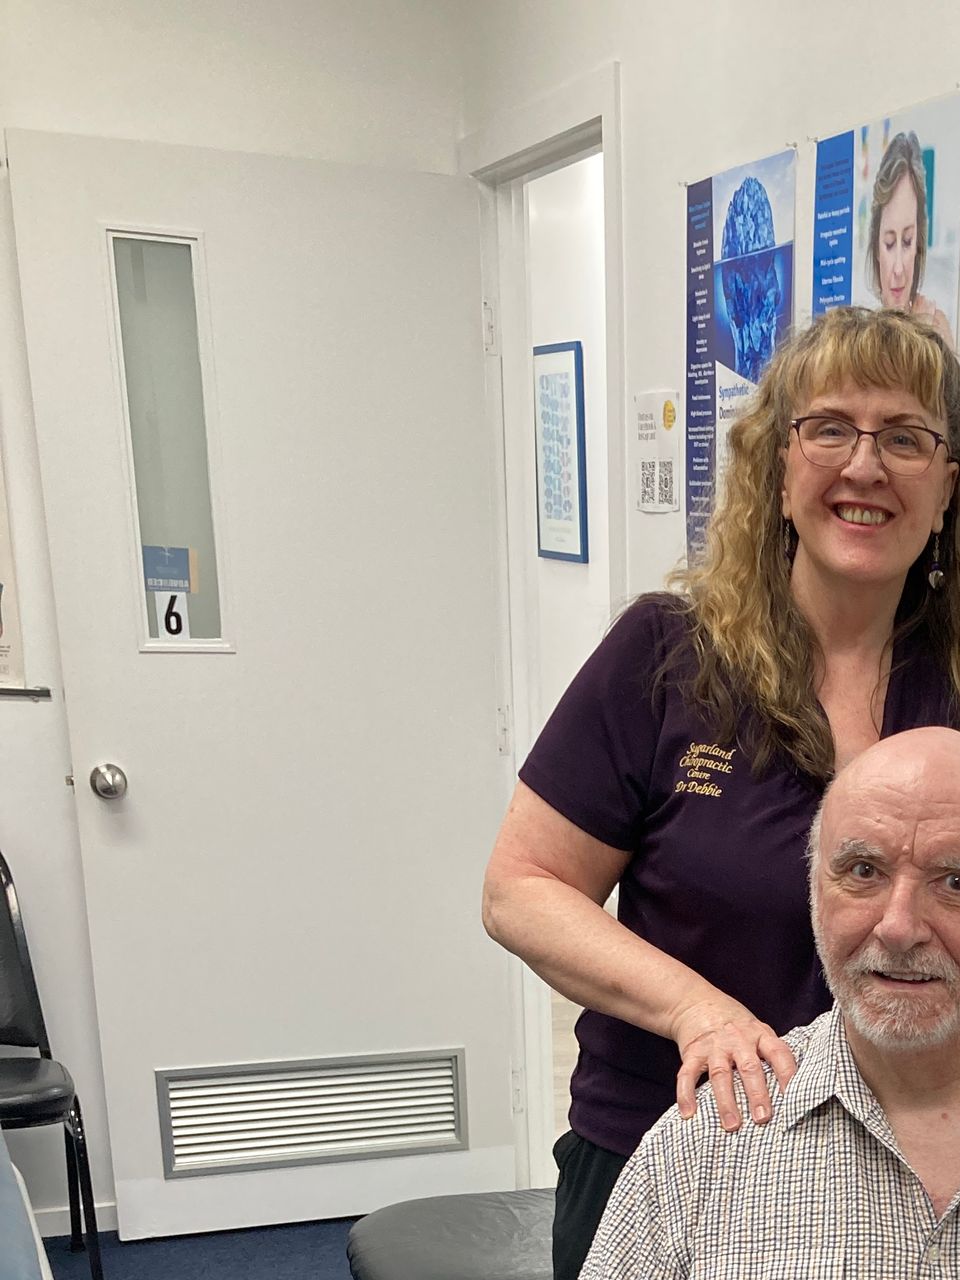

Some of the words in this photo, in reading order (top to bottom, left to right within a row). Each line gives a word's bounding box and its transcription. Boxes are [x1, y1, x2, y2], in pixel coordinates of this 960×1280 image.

[719, 383, 749, 401] Sympathetic
[164, 594, 183, 636] 6
[686, 742, 737, 760] Sugarland
[679, 754, 733, 774] Chiropractic
[686, 768, 711, 780] Centre
[675, 781, 687, 793] Dr
[687, 781, 723, 797] Debbie
